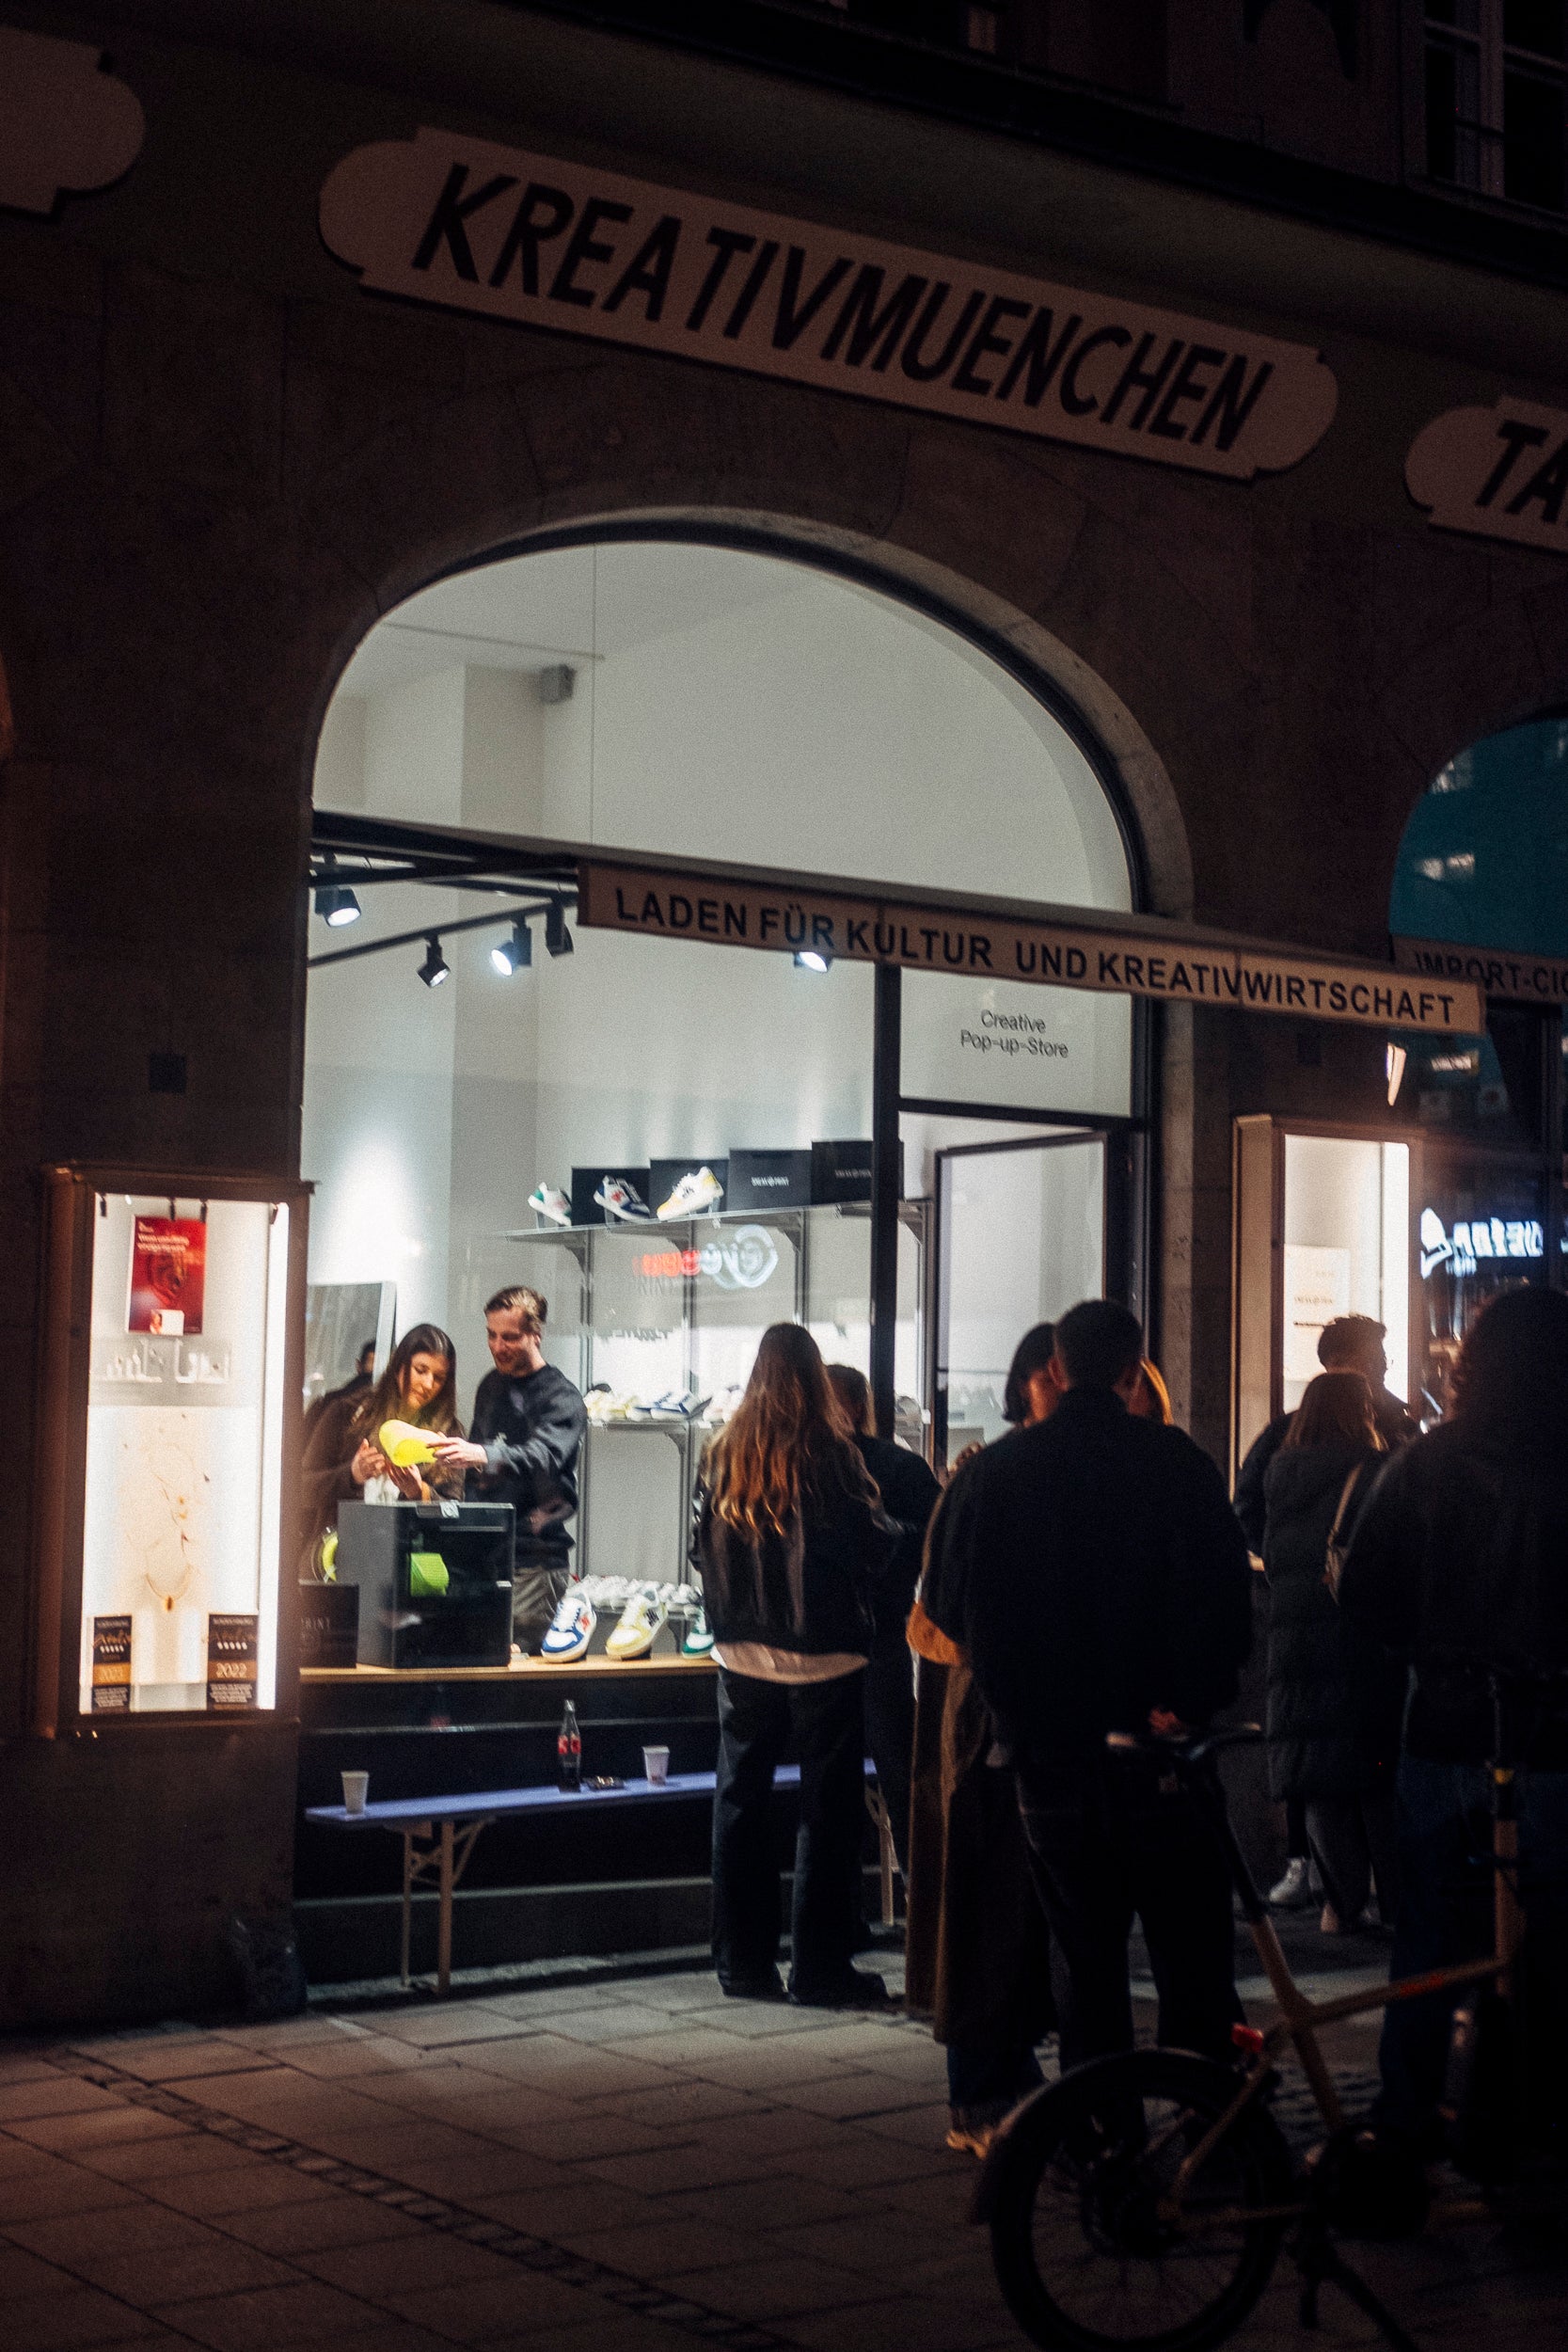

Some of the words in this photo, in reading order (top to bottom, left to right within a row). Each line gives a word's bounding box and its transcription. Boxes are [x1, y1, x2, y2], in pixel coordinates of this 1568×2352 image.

[412, 163, 1273, 452] KREATIVMUENCHEN
[616, 888, 748, 939] LADEN
[759, 904, 836, 949] FÜR
[847, 918, 993, 969] KULTUR
[1015, 941, 1087, 979] UND
[1099, 950, 1455, 1025] KREATIVWIRTSCHAFT
[960, 1029, 1069, 1058] Pop-up-Store
[980, 1009, 1047, 1033] Creative
